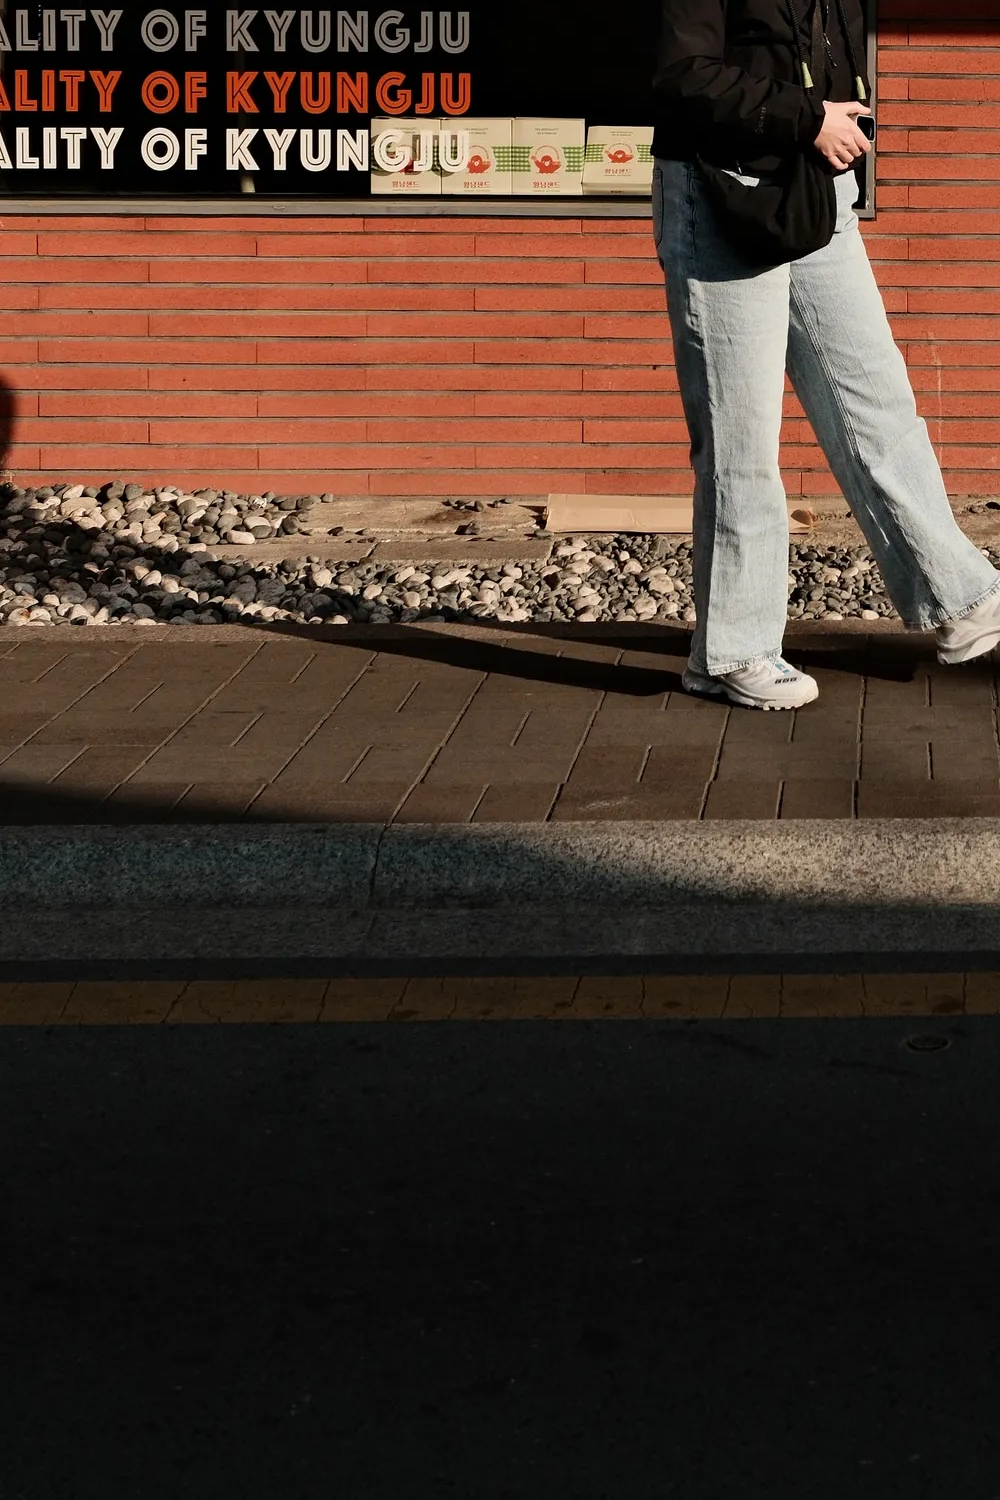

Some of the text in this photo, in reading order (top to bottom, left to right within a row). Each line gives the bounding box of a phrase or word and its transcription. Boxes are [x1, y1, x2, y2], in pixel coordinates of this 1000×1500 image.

[141, 9, 207, 52] OF
[226, 10, 470, 53] KYUNGJU
[141, 70, 207, 114] OF
[226, 71, 471, 115] KYUNGJU
[141, 128, 208, 171] OF
[226, 129, 470, 172] KYUNGJU
